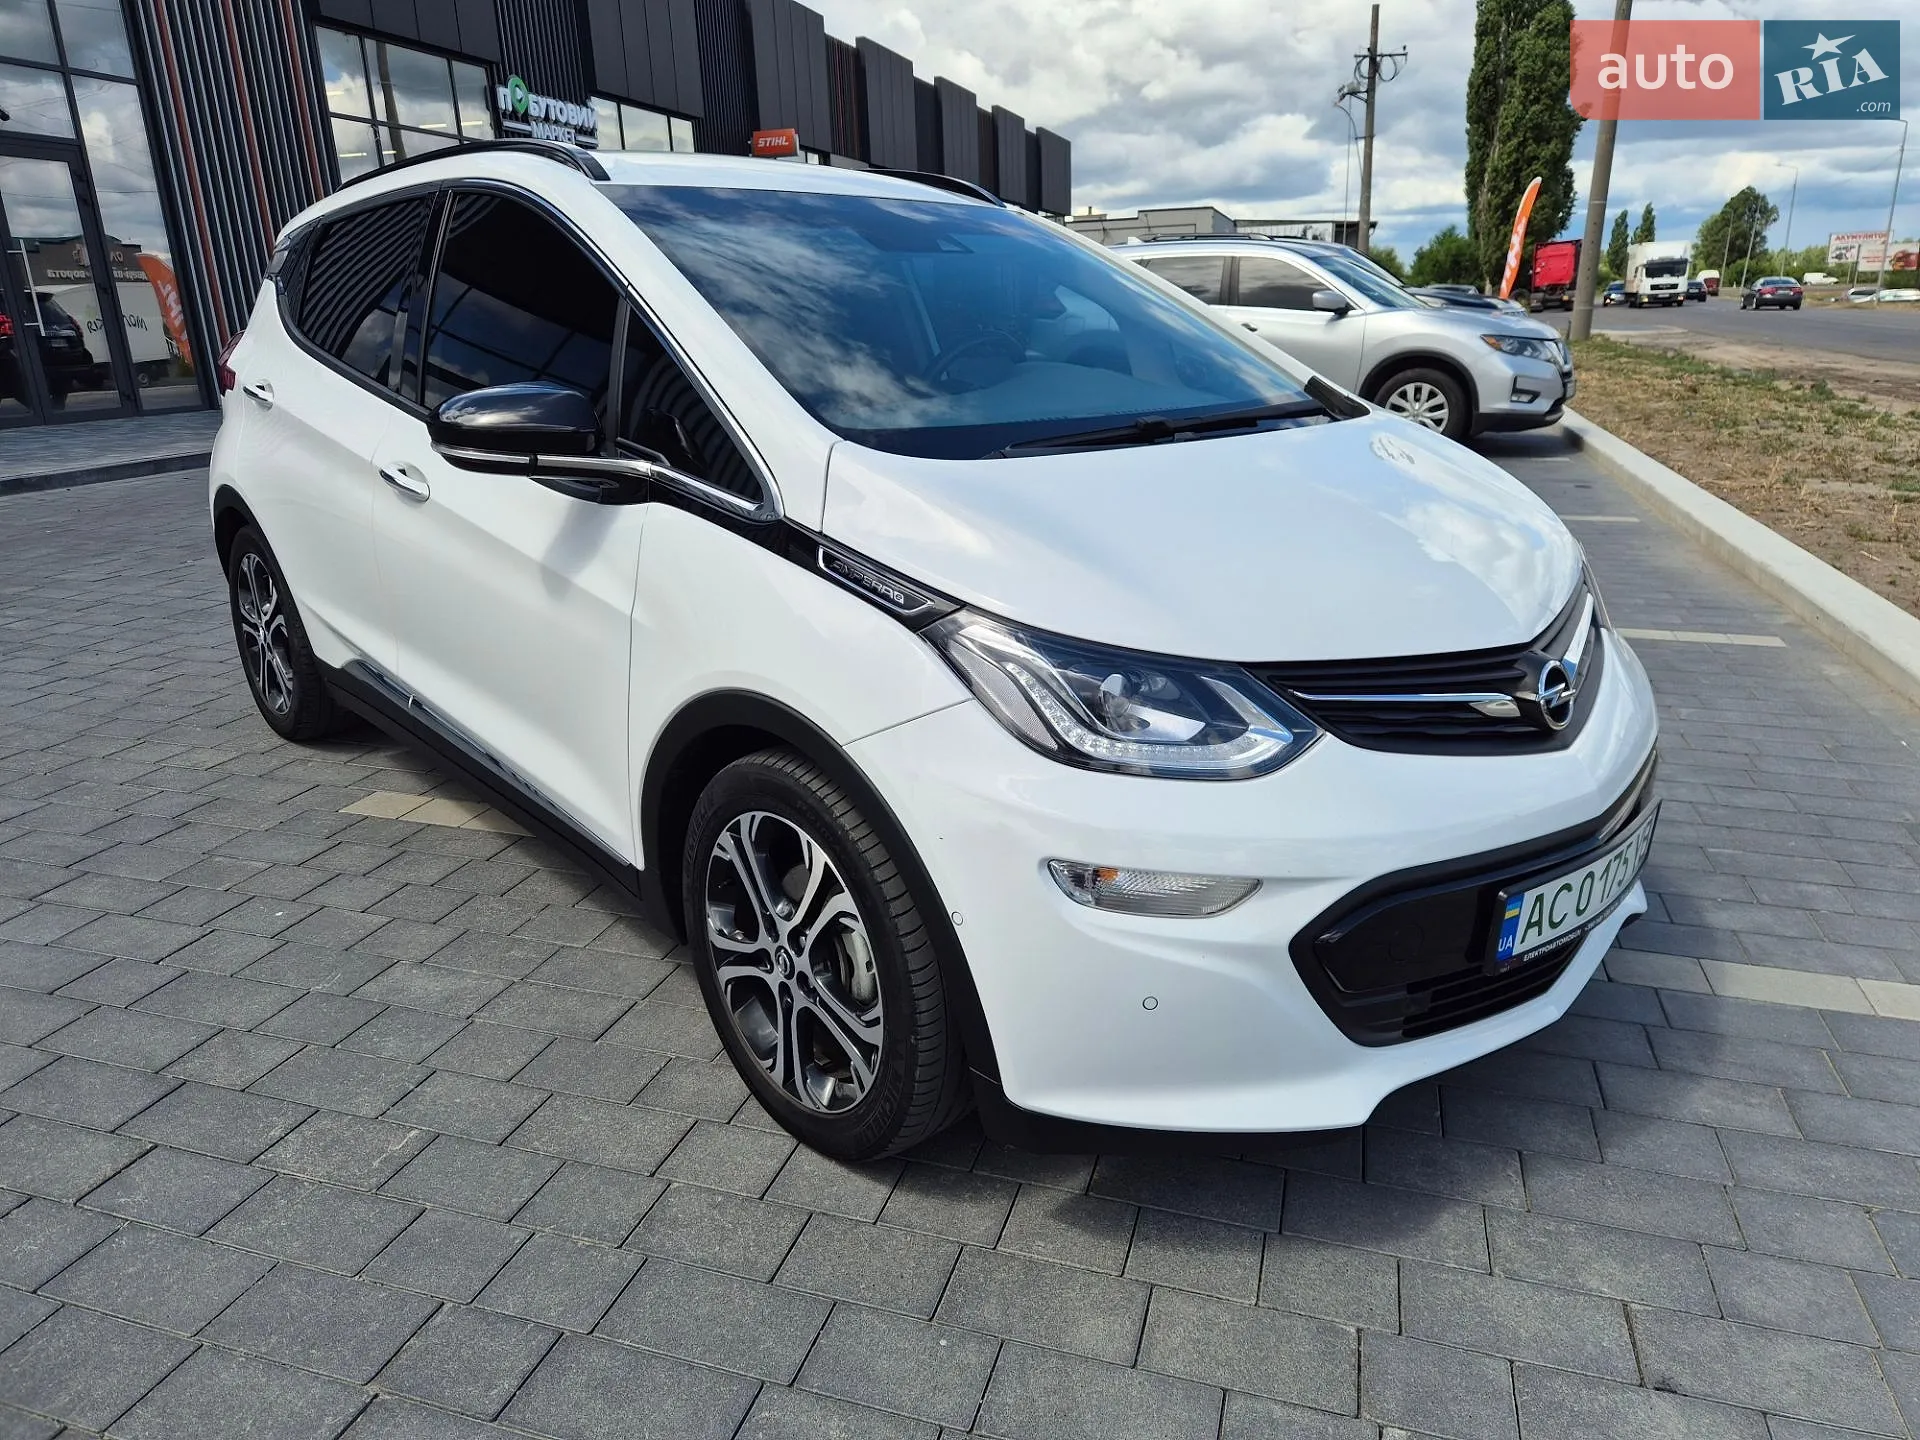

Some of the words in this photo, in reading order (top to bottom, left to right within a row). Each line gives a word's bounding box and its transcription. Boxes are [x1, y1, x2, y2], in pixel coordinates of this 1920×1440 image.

[530, 121, 577, 145] МАРКЕТ
[757, 136, 789, 148] STIHL
[1520, 882, 1574, 945] AC
[1575, 841, 1633, 917] 0175
[1498, 934, 1513, 952] UA
